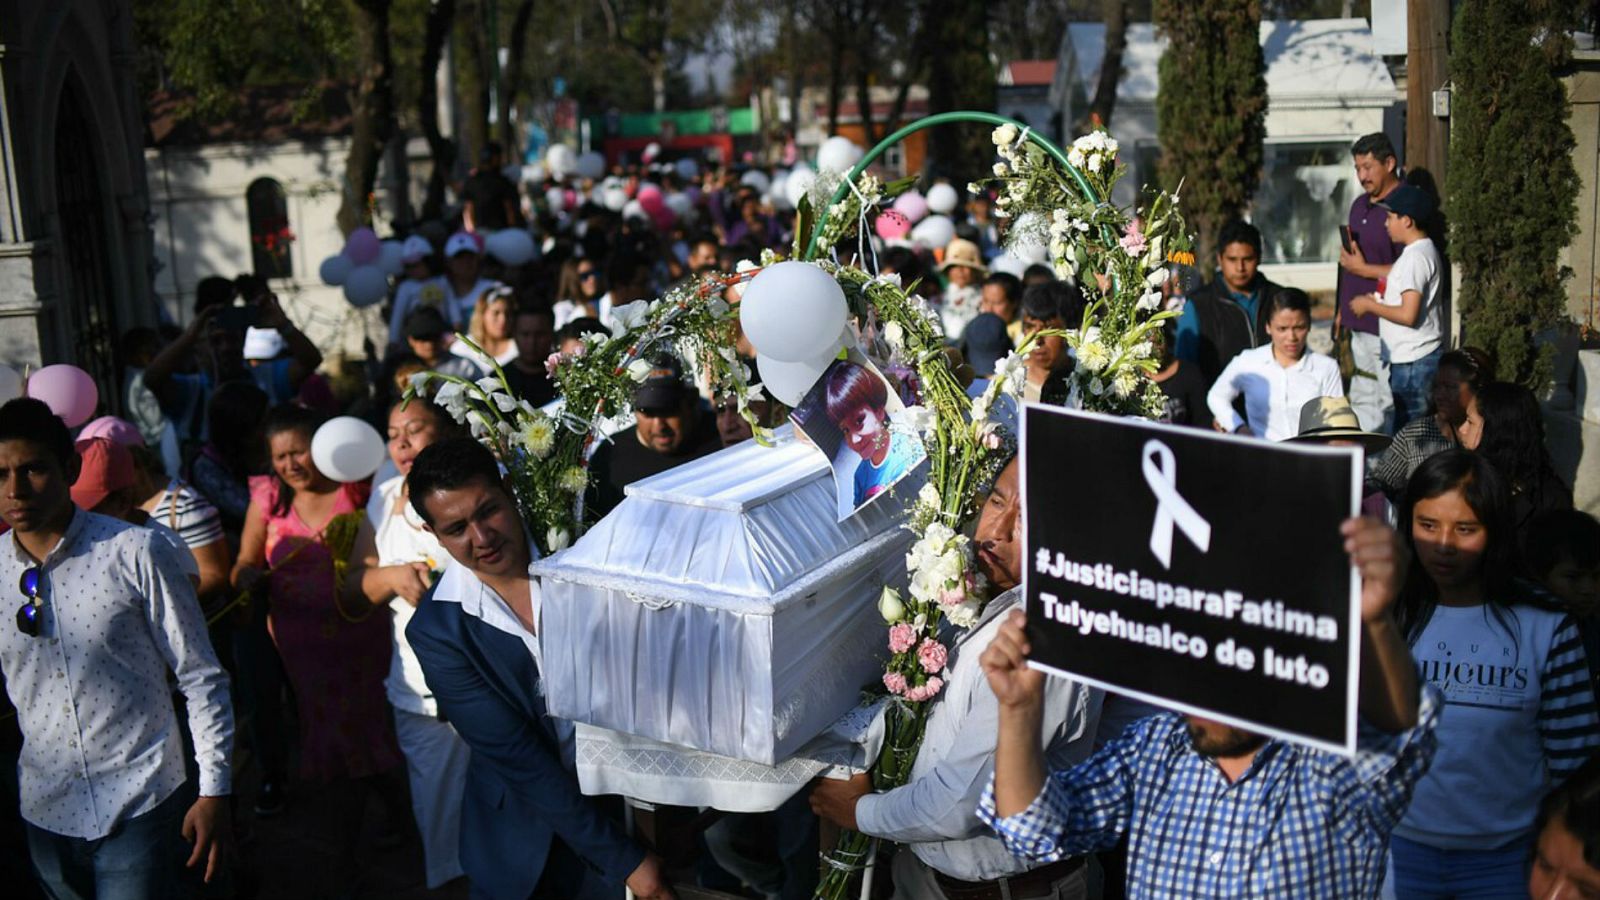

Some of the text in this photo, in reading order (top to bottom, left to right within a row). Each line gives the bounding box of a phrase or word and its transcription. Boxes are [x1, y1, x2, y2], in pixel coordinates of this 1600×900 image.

[1036, 548, 1338, 641] #JusticiaparaFatima
[1040, 593, 1330, 689] Tulyehualco de luto
